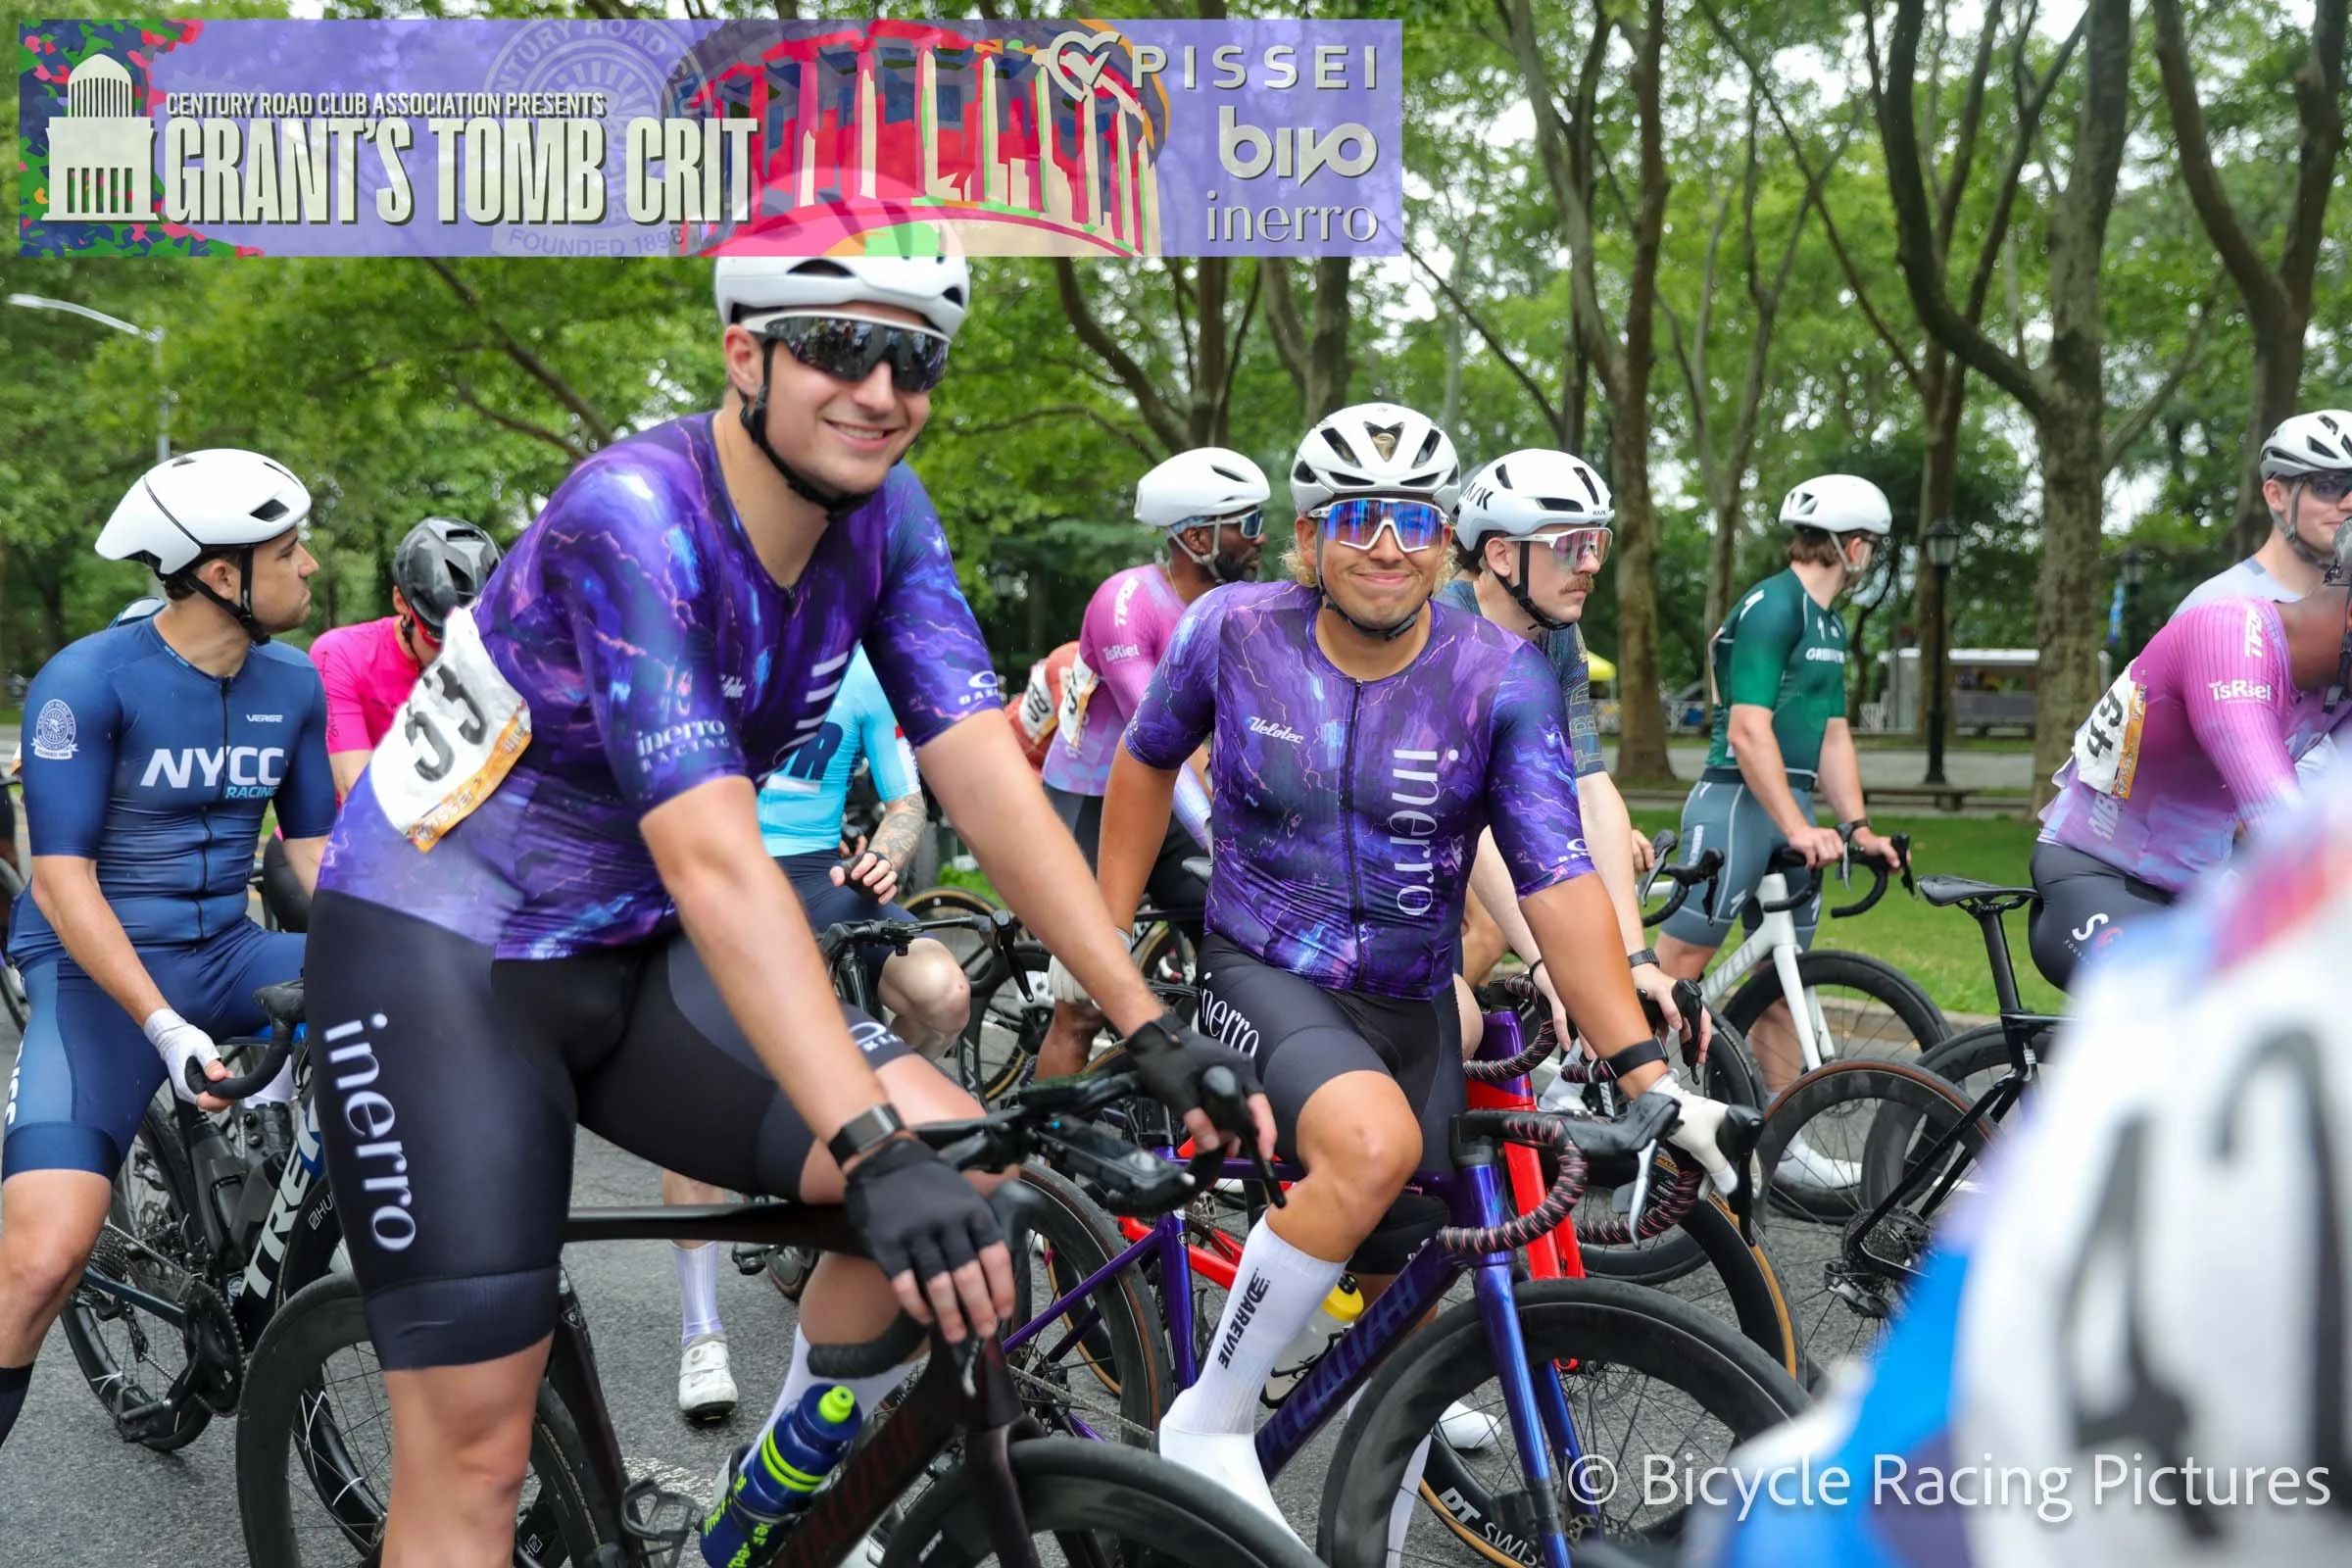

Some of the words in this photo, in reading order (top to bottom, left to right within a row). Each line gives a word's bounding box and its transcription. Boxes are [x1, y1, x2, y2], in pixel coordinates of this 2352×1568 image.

[246, 713, 283, 723] VERGE
[635, 719, 726, 757] inerro
[1249, 715, 1304, 745] Velotec
[2086, 689, 2124, 759] 49
[139, 746, 285, 789] NYCC
[1390, 749, 1459, 916] inerro
[324, 1012, 416, 1252] inerro
[240, 1093, 321, 1299] TREK
[1438, 1486, 1482, 1523] DT
[1484, 1521, 1538, 1567] SWI
